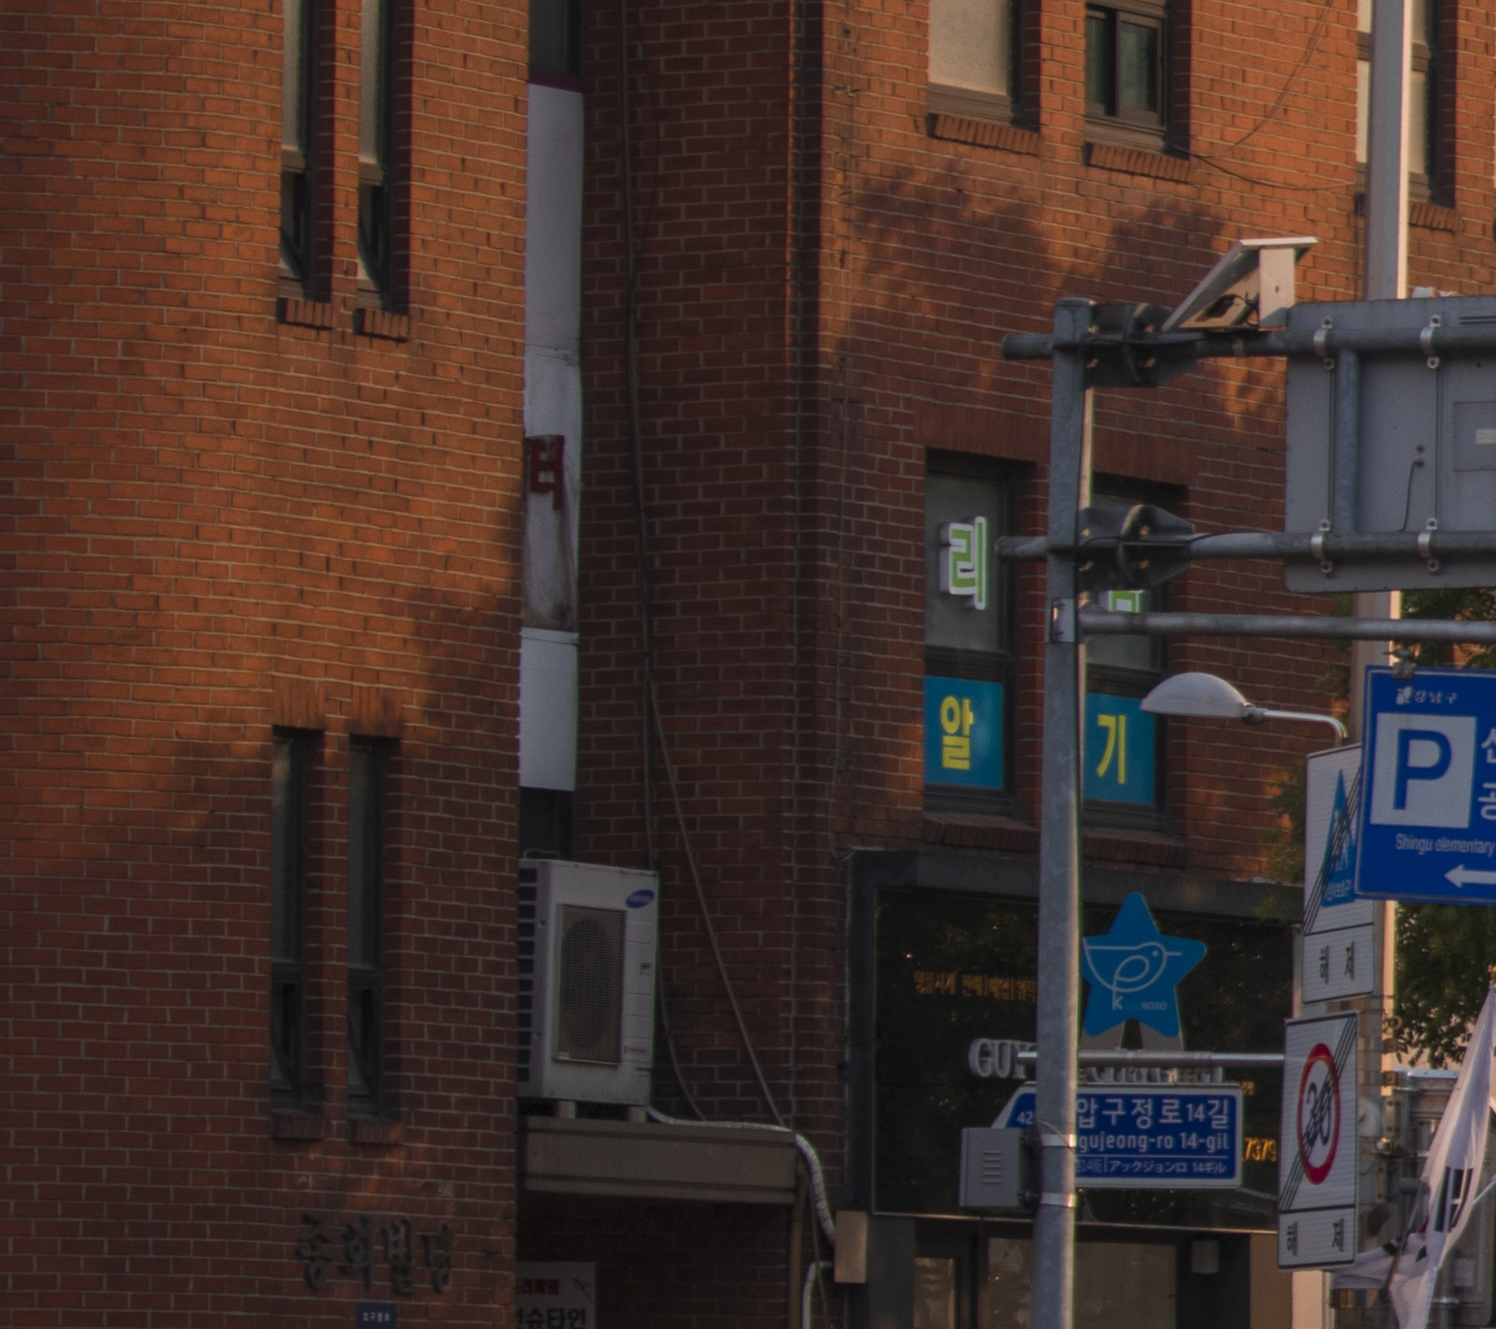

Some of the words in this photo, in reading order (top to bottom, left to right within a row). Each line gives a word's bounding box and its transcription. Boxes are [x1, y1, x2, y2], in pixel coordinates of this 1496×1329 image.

[1413, 689, 1459, 705] 강남구
[1395, 832, 1433, 856] Shingu
[1435, 835, 1496, 858] elementary
[1079, 1132, 1175, 1153] gujeong-ro
[1179, 1131, 1230, 1153] 14-gil
